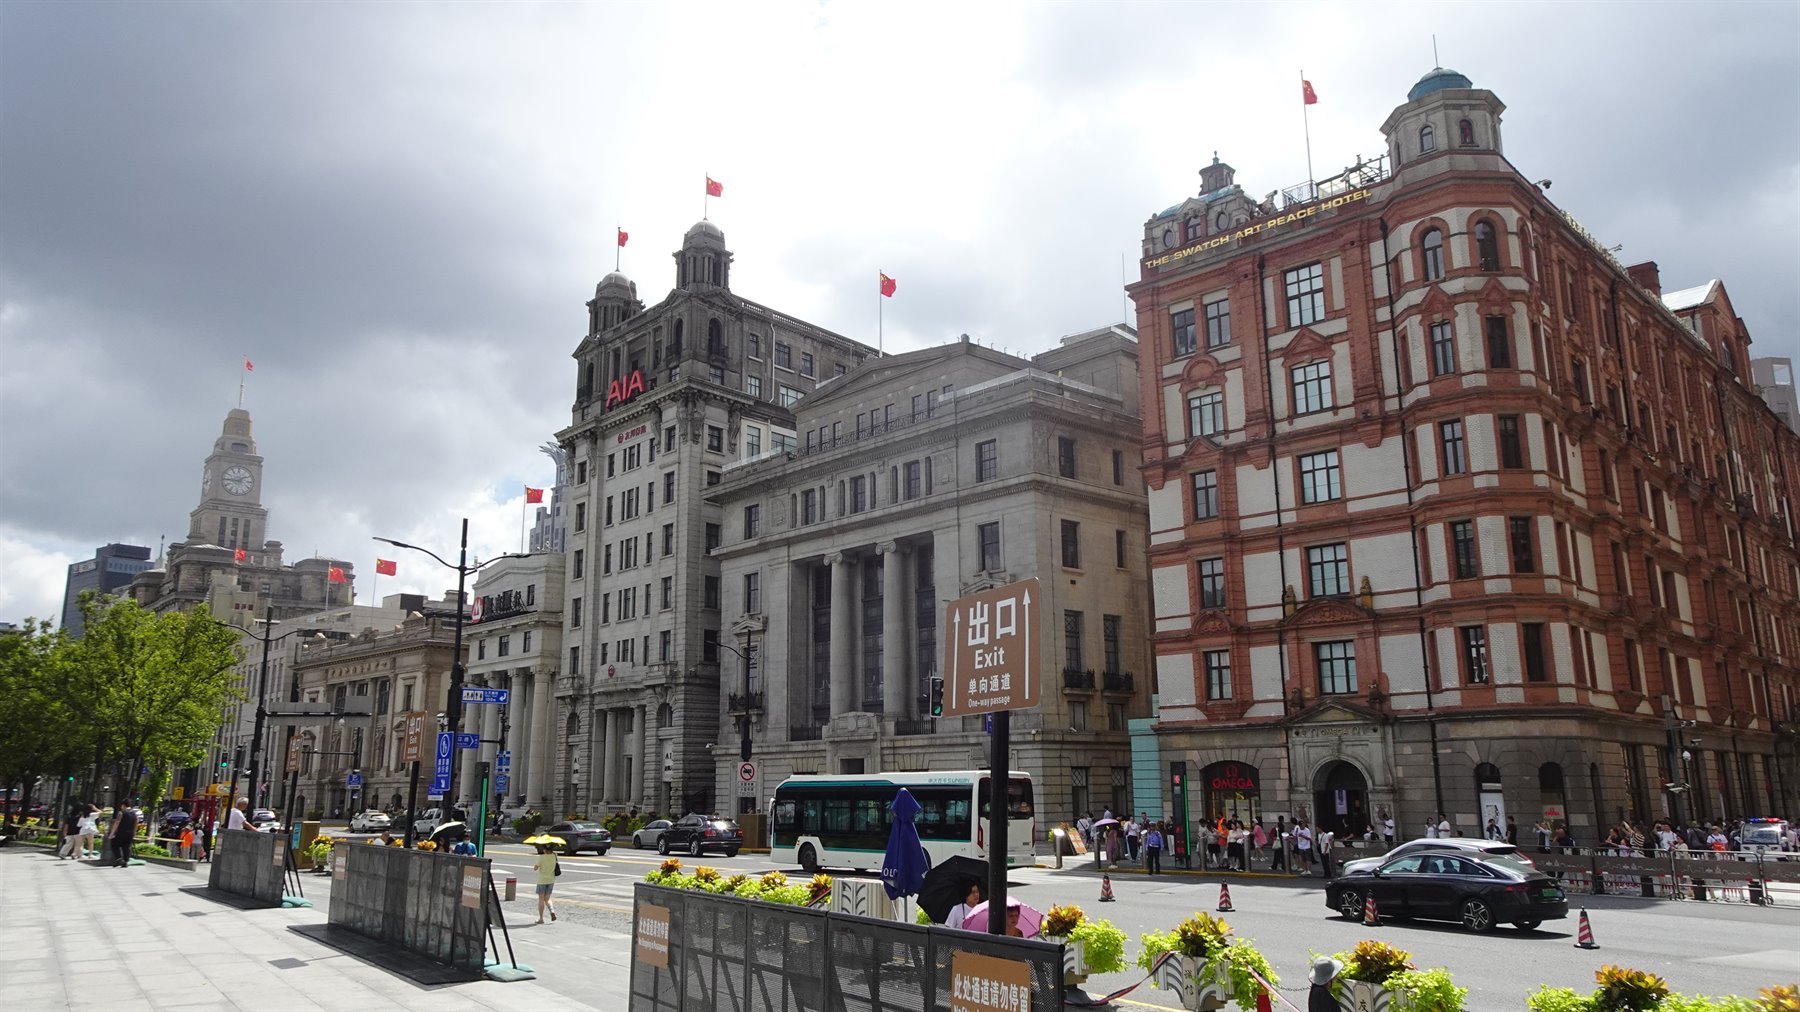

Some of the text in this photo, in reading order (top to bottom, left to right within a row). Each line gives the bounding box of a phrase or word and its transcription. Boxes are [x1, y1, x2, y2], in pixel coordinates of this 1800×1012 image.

[1146, 189, 1373, 269] THE SWATCH ART PEACE HOTEL
[606, 370, 643, 409] AIA
[967, 597, 1017, 647] 出口
[974, 646, 1005, 670] Exit
[968, 672, 1011, 694] 单向通道
[968, 695, 1011, 708] One-way passage
[1321, 728, 1348, 737] OMEGA
[1212, 777, 1255, 790] OMEGA
[954, 973, 1029, 1012] 此处通道请勿停留
